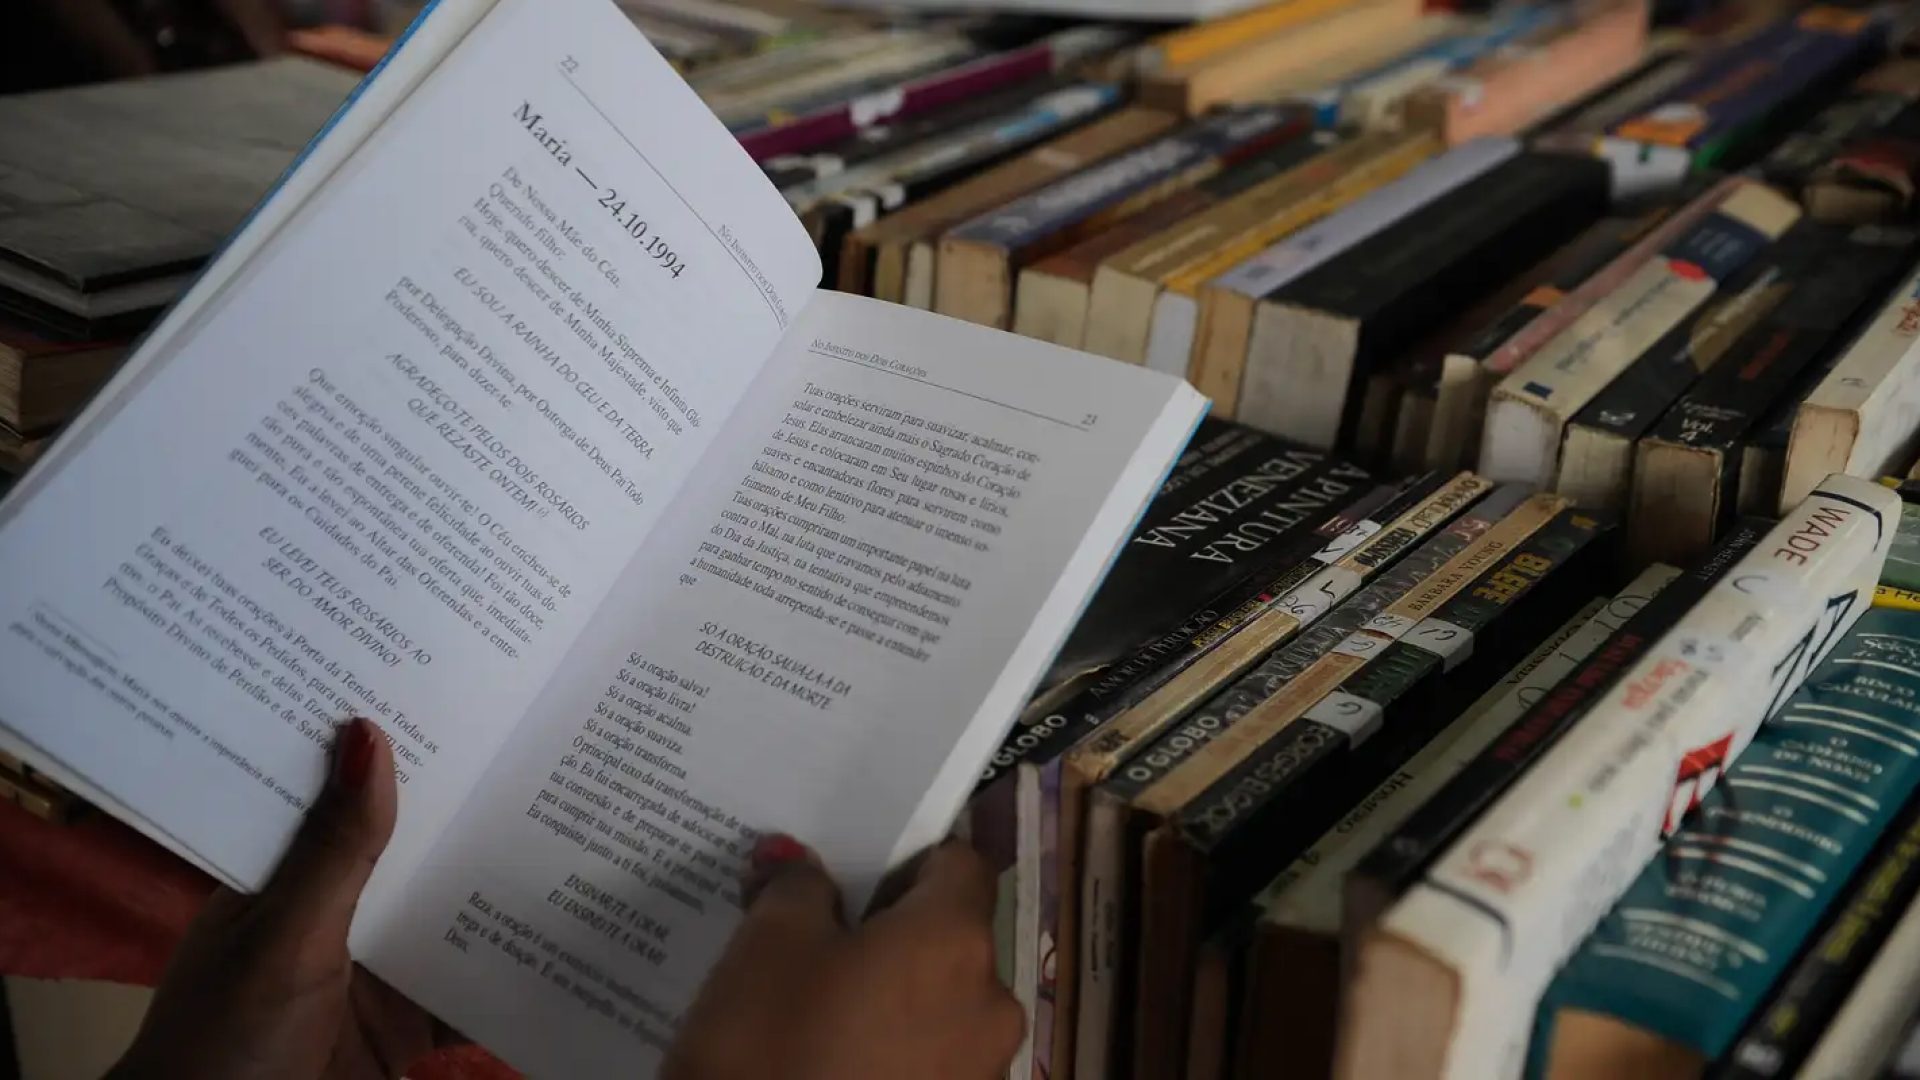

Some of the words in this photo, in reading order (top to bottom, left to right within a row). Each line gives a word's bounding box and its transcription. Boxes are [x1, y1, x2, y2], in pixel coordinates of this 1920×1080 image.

[559, 54, 579, 74] 22
[488, 181, 535, 230] Querido
[512, 101, 571, 167] Maria
[597, 187, 686, 279] 24.10.1994
[555, 218, 583, 248] Mãe
[478, 234, 514, 268] quero
[512, 265, 551, 301] descer
[562, 311, 598, 350] Minha
[596, 344, 647, 401] Majestade,
[647, 395, 669, 421] visto
[665, 417, 683, 436] que
[503, 229, 537, 262] quero
[534, 258, 572, 294] descer
[581, 301, 616, 339] Minha
[612, 333, 656, 379] Suprema
[438, 343, 469, 370] para
[452, 266, 478, 287] EU
[471, 285, 506, 312] SOU
[510, 320, 560, 367] RAINHA
[554, 362, 579, 383] DO
[603, 408, 624, 428] DA
[406, 397, 440, 426] QUE
[434, 421, 493, 471] REZASTE
[476, 344, 516, 387] Divina,
[512, 382, 538, 403] por
[535, 398, 577, 441] Outorga
[586, 445, 611, 475] Deus
[802, 381, 825, 398] Tuas
[823, 390, 860, 408] orações
[859, 400, 902, 421] serviram
[899, 414, 925, 428] para
[1080, 413, 1098, 426] 23
[467, 423, 511, 459] PELOS
[504, 455, 539, 484] DOIS
[783, 431, 810, 449] Jesus
[818, 445, 869, 470] colocaram
[888, 465, 909, 483] Seu
[909, 473, 938, 492] lugar
[791, 399, 814, 413] solar
[820, 408, 869, 430] embelezar
[867, 422, 895, 439] ainda
[895, 431, 920, 446] mais
[928, 438, 972, 462] Sagrado
[971, 452, 1016, 476] Coração
[807, 419, 830, 436] Elas
[827, 429, 882, 454] arrancaram
[881, 446, 917, 465] muitos
[915, 458, 961, 480] espinhos
[308, 367, 336, 394] Que
[382, 431, 430, 475] singular
[427, 472, 480, 517] ouvir-te!
[488, 521, 513, 547] Céu
[510, 543, 560, 588] encheu-se
[740, 473, 781, 498] frimento
[793, 493, 818, 512] Meu
[750, 458, 790, 481] bálsamo
[824, 485, 864, 508] lenitivo
[861, 501, 886, 517] para
[760, 445, 792, 462] suaves
[801, 459, 865, 488] encantadoras
[865, 479, 896, 499] flores
[894, 492, 920, 508] para
[1133, 450, 1324, 550] VENEZIANA
[1331, 461, 1371, 485] A
[304, 505, 360, 556] Cuidados
[358, 441, 387, 468] uma
[382, 463, 427, 500] perene
[424, 495, 480, 546] felicidade
[492, 555, 523, 582] ouvir
[519, 577, 543, 600] tuas
[364, 474, 409, 514] entrega
[430, 530, 488, 575] oferenda!
[483, 571, 504, 594] Foi
[501, 589, 521, 608] tão
[719, 509, 750, 526] contra
[794, 534, 816, 553] luta
[815, 546, 836, 560] que
[835, 553, 882, 578] travamos
[1190, 476, 1350, 566] PINTURA
[1774, 505, 1851, 567] WADE
[365, 529, 398, 557] Altar
[394, 555, 418, 576] das
[416, 570, 473, 622] Oferendas
[718, 548, 752, 568] ganhar
[750, 560, 783, 581] tempo
[795, 579, 834, 602] sentido
[722, 526, 742, 543] Dia
[807, 562, 852, 588] tentativa
[1406, 562, 1462, 613] BARBARA
[1461, 539, 1505, 576] YOUNG
[257, 525, 285, 545] EU
[278, 541, 318, 573] LEVEI
[313, 569, 352, 600] TEUS
[411, 648, 432, 665] AO
[260, 556, 291, 581] SER
[286, 576, 313, 597] DO
[311, 595, 355, 630] AMOR
[348, 625, 402, 667] DIVINO!
[407, 537, 428, 557] tua
[427, 554, 462, 586] oferta
[459, 583, 484, 607] que,
[484, 603, 531, 643] imediata-
[695, 556, 753, 589] humanidade
[774, 592, 839, 626] arrependa-se
[207, 594, 245, 631] Todos
[257, 635, 307, 681] Pedidos,
[305, 676, 336, 701] para
[236, 594, 284, 632] orações
[291, 633, 325, 665] Porta
[340, 669, 377, 705] Tenda
[391, 710, 425, 743] Todas
[625, 650, 642, 666] Só
[645, 662, 679, 684] oração
[677, 677, 710, 698] salva!
[624, 696, 657, 718] oração
[634, 680, 668, 701] oração
[666, 690, 696, 714] livra!
[602, 730, 635, 752] oração
[992, 713, 1068, 766] GLOBO
[1126, 766, 1148, 783] O
[1145, 715, 1220, 770] GLOBO
[564, 779, 612, 810] conversão
[577, 741, 623, 769] principal
[619, 761, 643, 780] eixo
[653, 778, 729, 827] transformação
[607, 779, 668, 817] encarregada
